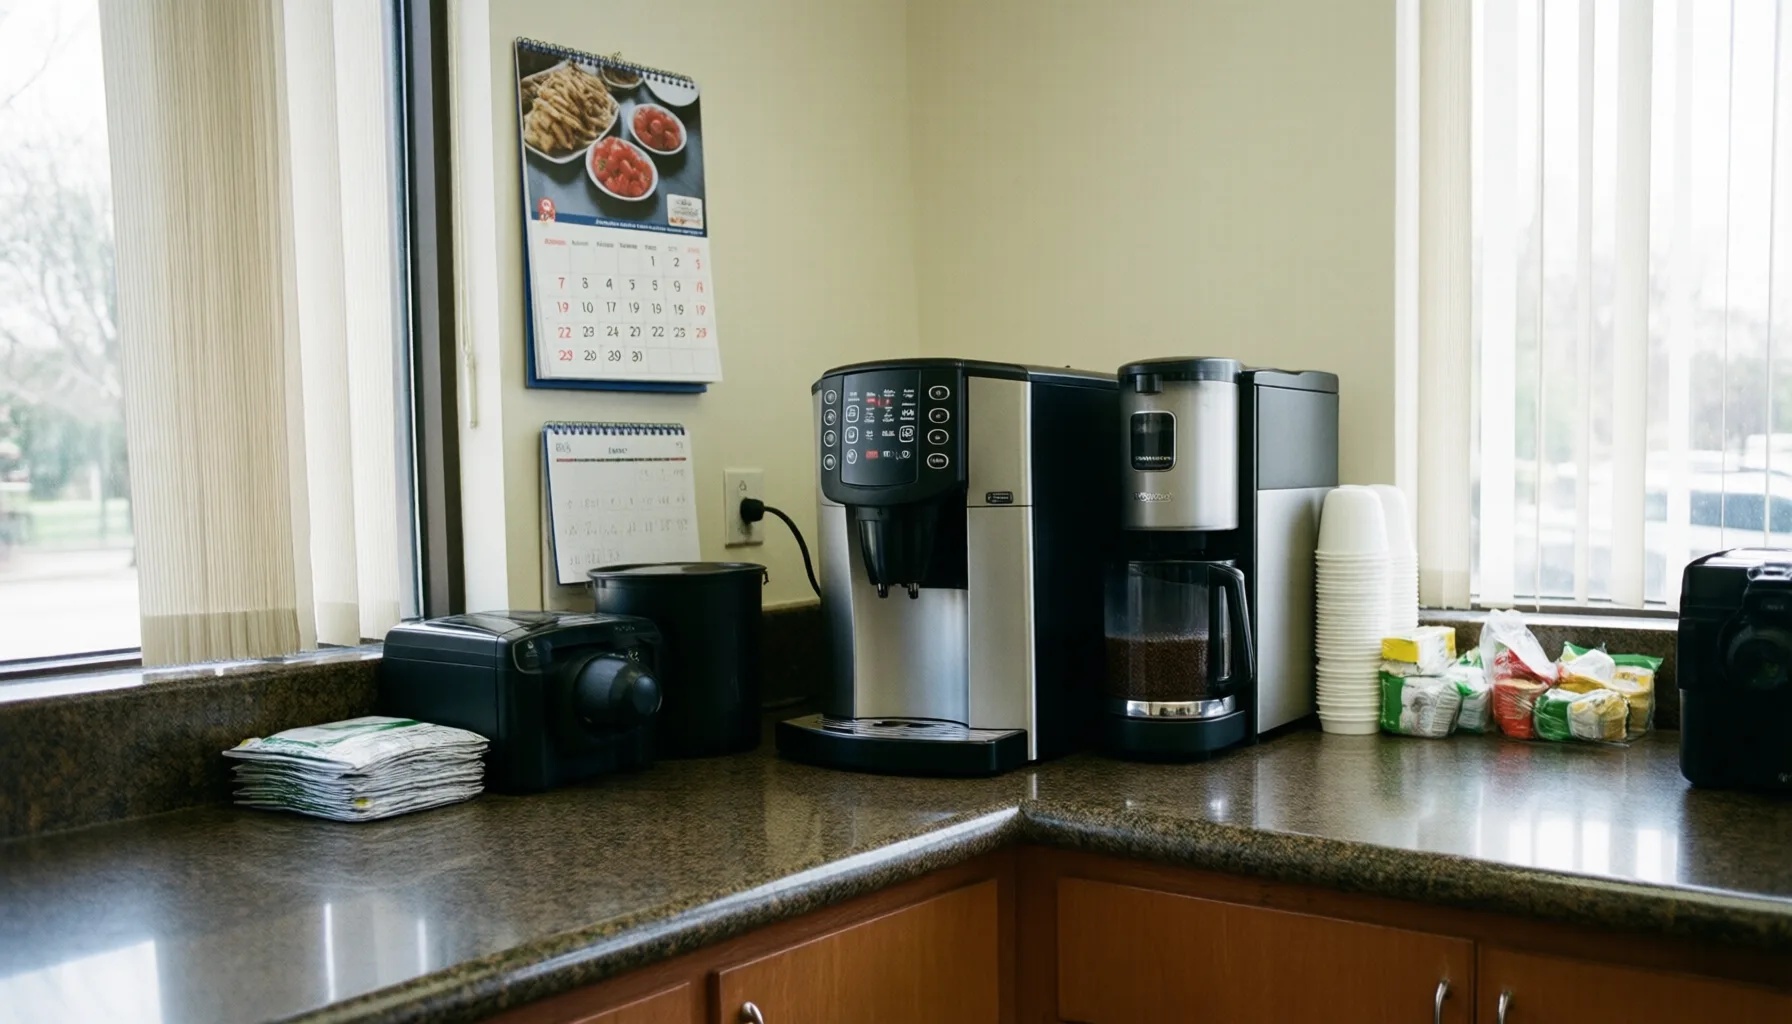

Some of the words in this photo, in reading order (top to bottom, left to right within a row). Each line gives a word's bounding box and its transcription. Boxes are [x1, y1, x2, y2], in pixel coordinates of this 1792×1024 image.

[651, 256, 655, 267] 1
[673, 257, 680, 268] 2
[558, 277, 566, 289] 7
[557, 301, 569, 313] 19
[582, 301, 594, 314] 10
[606, 301, 617, 313] 17
[629, 302, 640, 314] 19
[558, 326, 572, 339] 22
[583, 325, 595, 338] 23
[652, 326, 665, 338] 22
